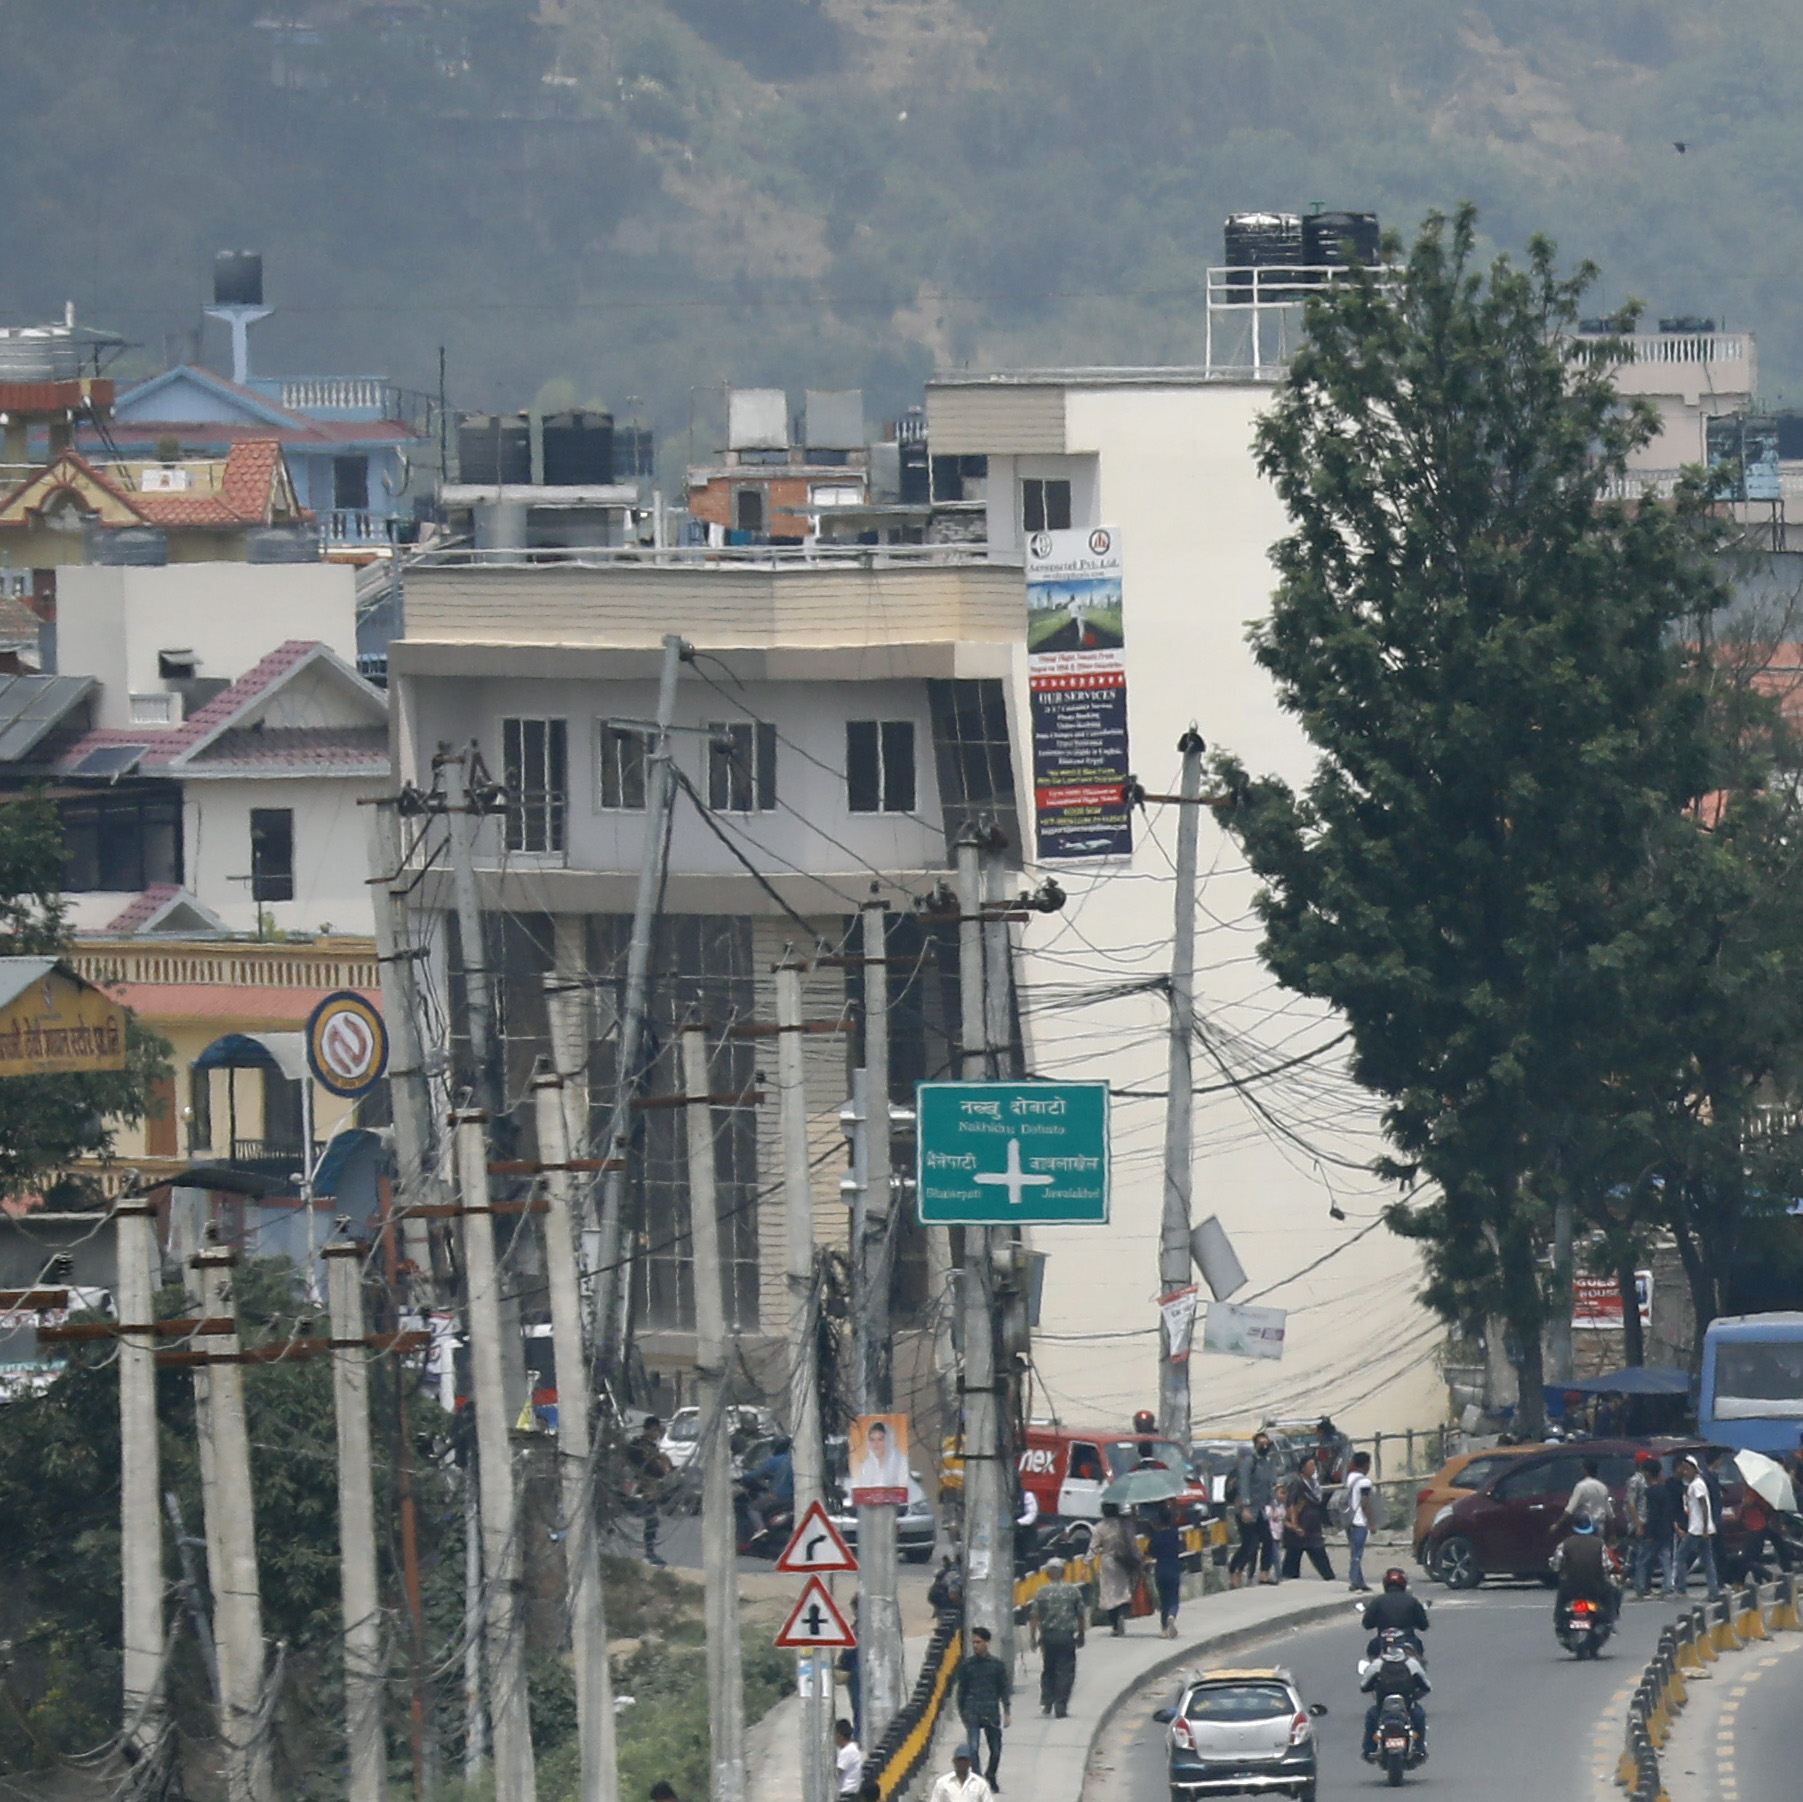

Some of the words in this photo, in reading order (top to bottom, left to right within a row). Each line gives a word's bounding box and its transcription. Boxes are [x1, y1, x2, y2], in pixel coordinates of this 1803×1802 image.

[1064, 689, 1116, 701] SERVICES
[1576, 1278, 1618, 1288] GUES
[1019, 1449, 1056, 1474] nex
